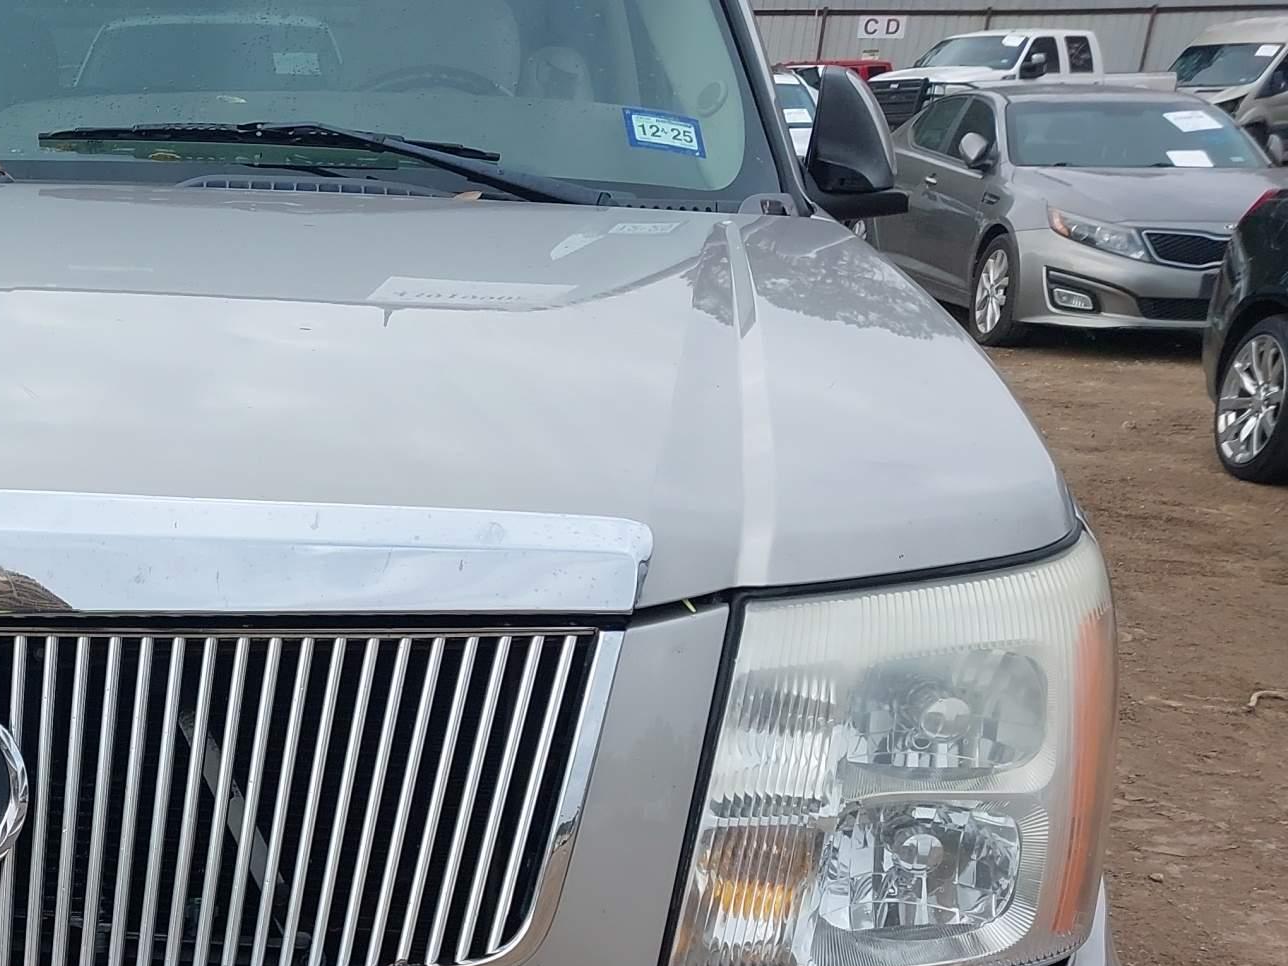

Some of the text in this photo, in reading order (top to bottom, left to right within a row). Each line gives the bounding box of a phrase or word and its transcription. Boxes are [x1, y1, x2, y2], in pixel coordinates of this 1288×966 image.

[864, 18, 900, 35] C D
[638, 123, 694, 144] 12 25
